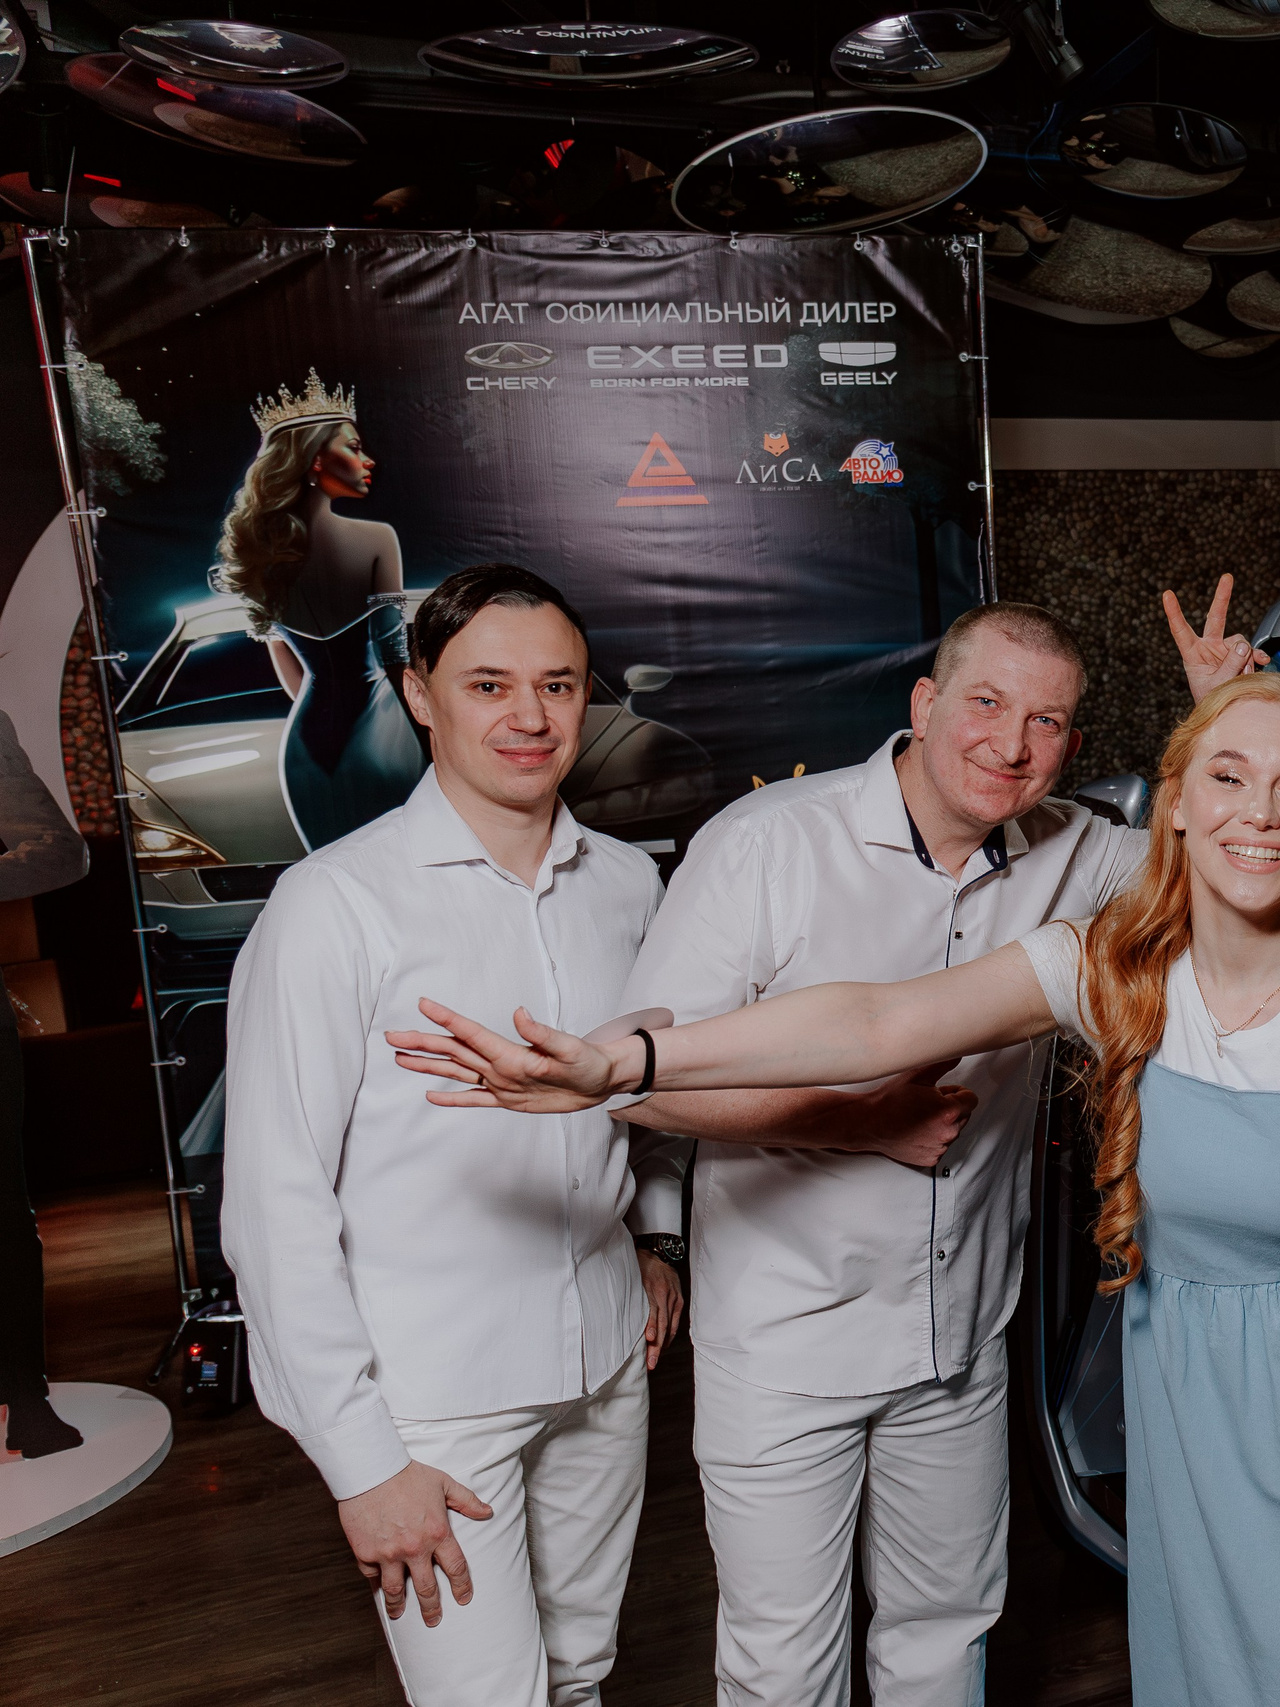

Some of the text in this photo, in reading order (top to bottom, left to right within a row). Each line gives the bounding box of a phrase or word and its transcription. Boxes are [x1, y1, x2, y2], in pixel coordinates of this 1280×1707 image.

[458, 297, 897, 327] АГАТ ОФИЦИАЛЬНЫЙ ДИЛЕР
[586, 344, 789, 369] EXEED
[466, 376, 558, 391] CHERY
[590, 376, 749, 388] BORN FOR MORE
[820, 371, 898, 386] GEELY
[839, 457, 881, 472] АВТО
[852, 469, 904, 484] РАДИО
